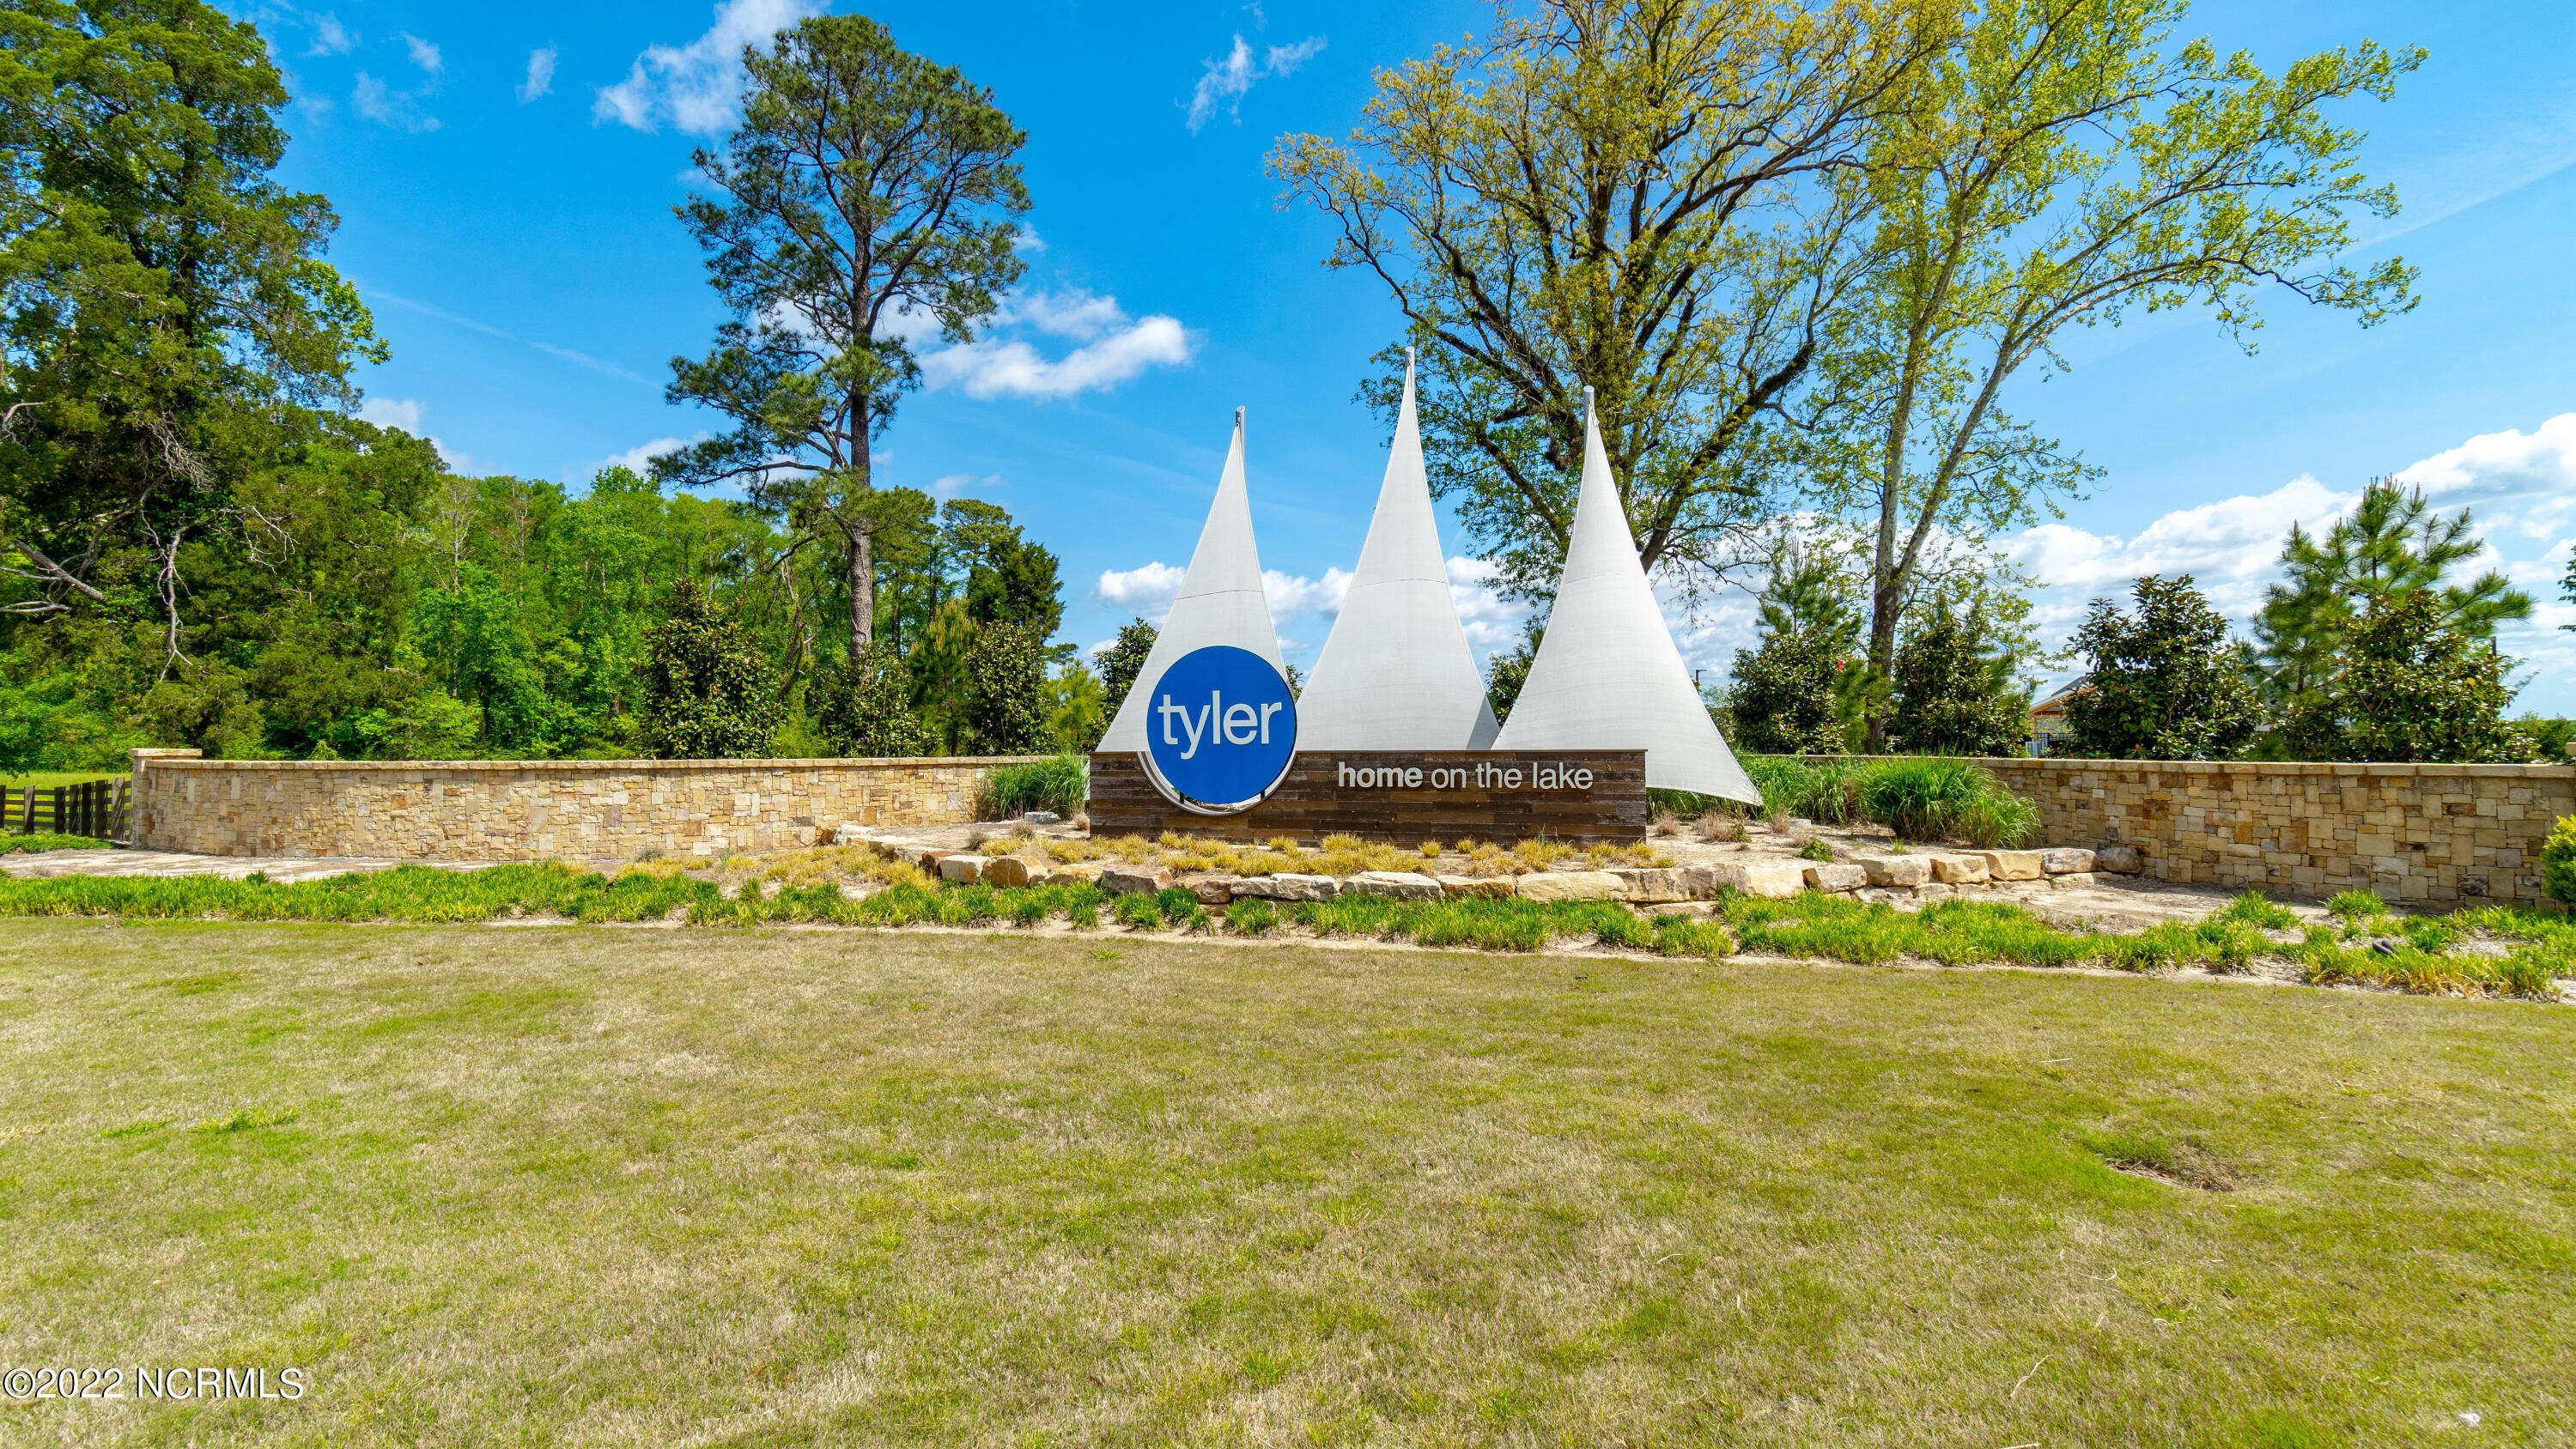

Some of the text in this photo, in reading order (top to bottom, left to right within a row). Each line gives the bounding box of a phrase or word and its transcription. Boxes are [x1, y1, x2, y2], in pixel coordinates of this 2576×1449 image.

[1157, 689, 1282, 761] tyler
[1338, 761, 1594, 790] home on the lake
